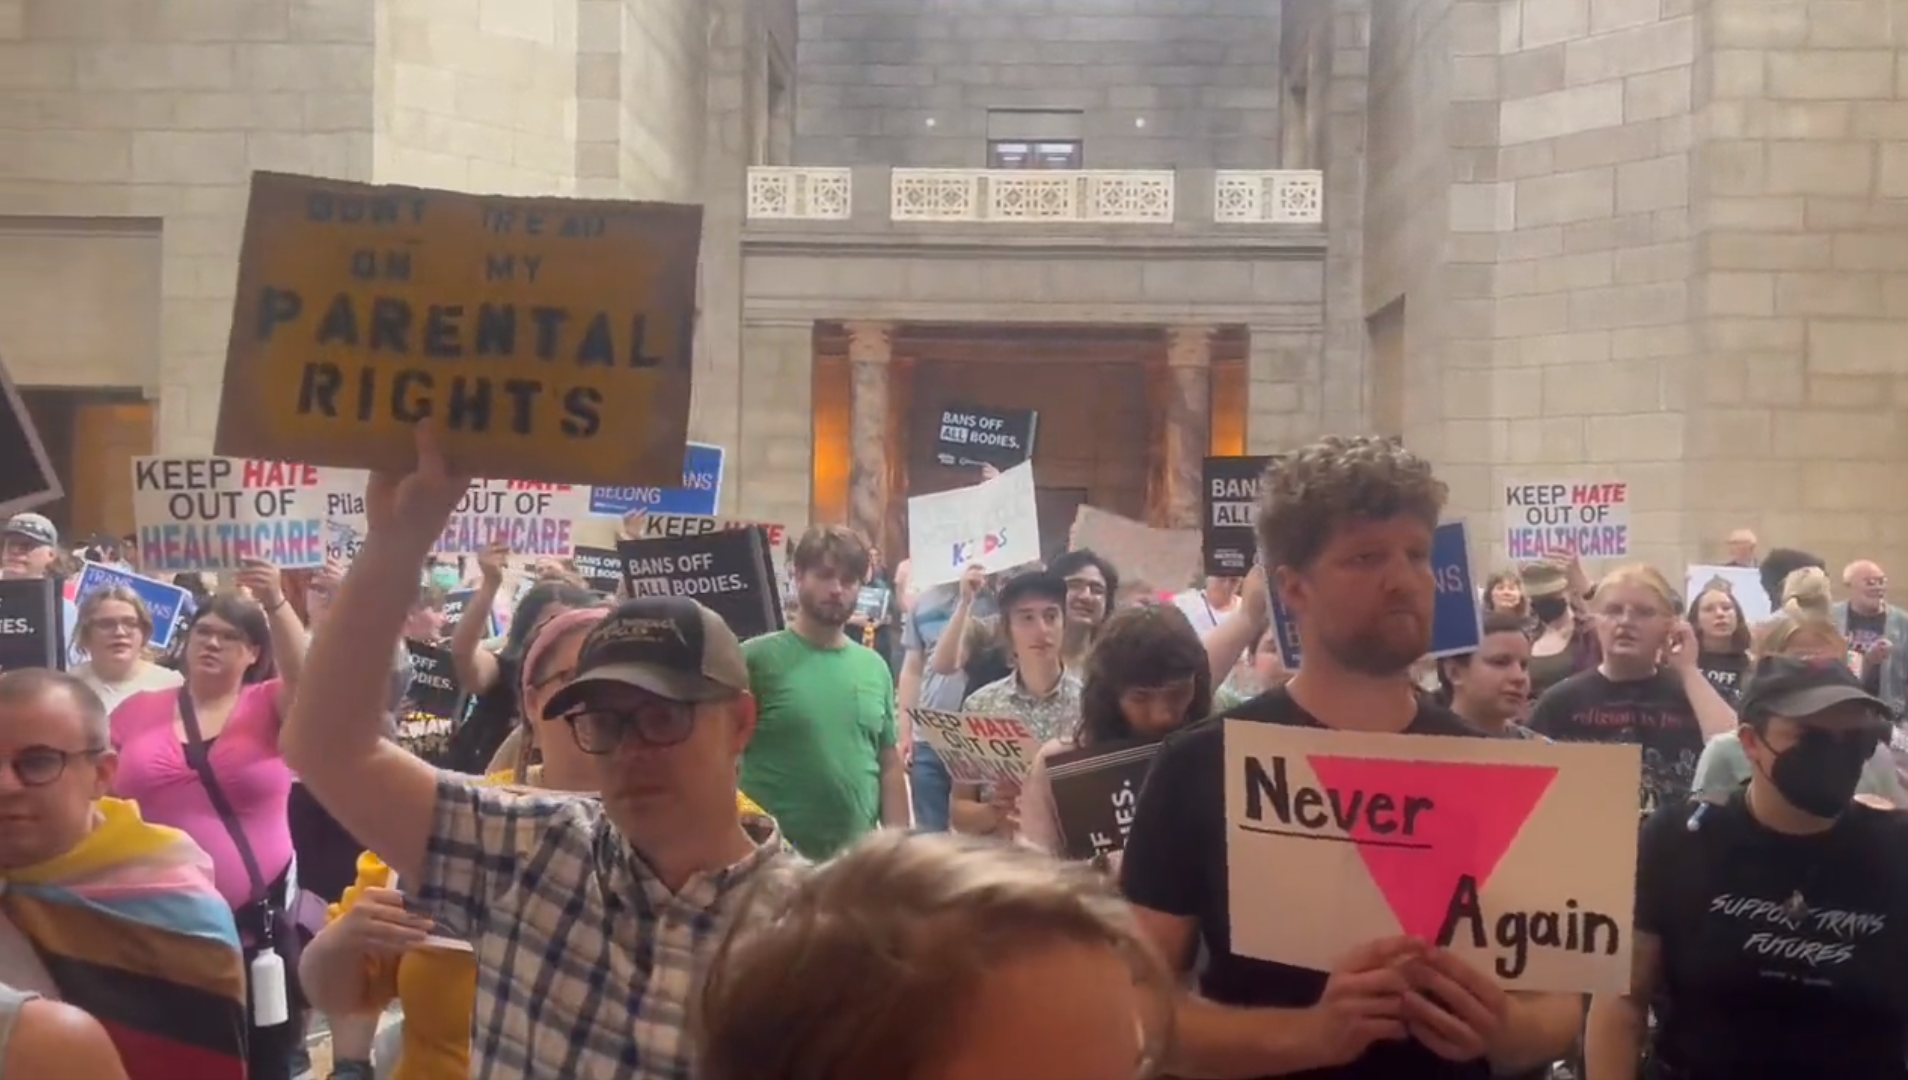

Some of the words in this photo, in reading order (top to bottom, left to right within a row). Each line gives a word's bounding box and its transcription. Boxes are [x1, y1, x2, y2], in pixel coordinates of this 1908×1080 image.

[351, 249, 413, 282] ON
[485, 252, 543, 284] MY
[257, 286, 664, 368] PARENTAL
[295, 361, 605, 438] RIGHTS
[942, 411, 976, 427] BANS
[978, 417, 1003, 431] OFF
[942, 426, 966, 443] ALL
[970, 431, 1020, 449] BODIES.
[136, 460, 231, 491] KEEP
[242, 460, 319, 488] HATE
[1212, 478, 1262, 498] BAN
[169, 491, 244, 520] OUT
[255, 489, 296, 517] OF
[455, 492, 507, 514] OUT
[514, 492, 552, 515] OF
[594, 486, 662, 505] BELONG
[1506, 485, 1566, 506] KEEP
[1571, 483, 1627, 505] HATE
[1526, 506, 1573, 525] OUT
[1580, 505, 1609, 524] OF
[142, 519, 322, 570] HEALTHCARE
[434, 516, 572, 556] EALTHCARE
[1508, 525, 1627, 558] HEALTHCARE
[628, 556, 675, 577] BANS
[677, 552, 714, 573] OFF
[637, 577, 670, 598] ALL
[672, 573, 749, 597] BODIES.
[906, 708, 962, 732] KEEP
[965, 716, 1033, 738] HATE
[941, 730, 985, 757] OUT
[989, 738, 1022, 758] OF
[1244, 756, 1435, 837] Never
[1437, 874, 1620, 979] Again
[1813, 908, 1887, 938] TRANS
[1743, 932, 1857, 968] FUTURES
